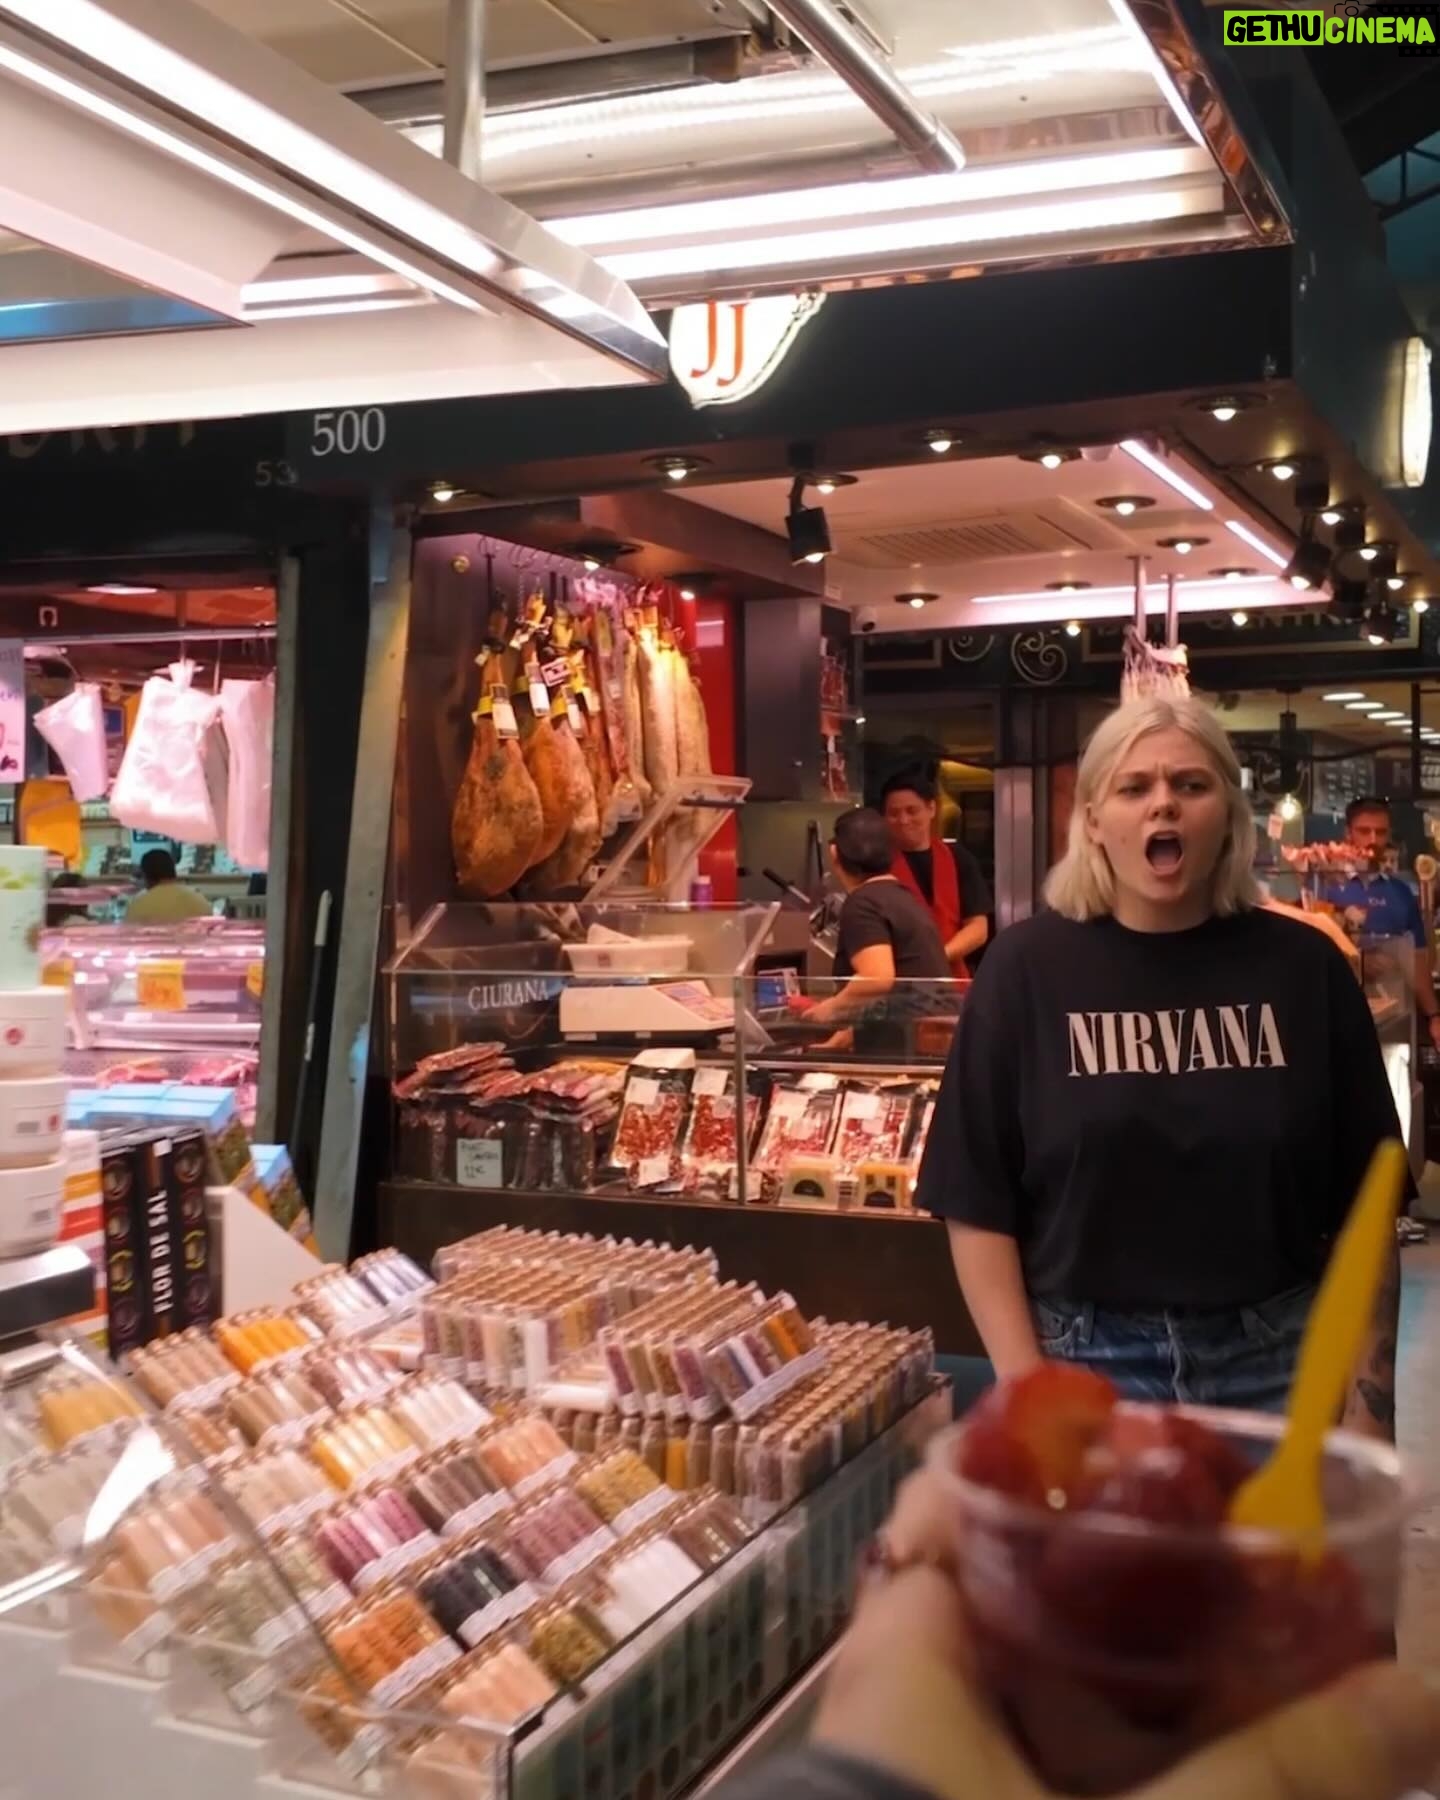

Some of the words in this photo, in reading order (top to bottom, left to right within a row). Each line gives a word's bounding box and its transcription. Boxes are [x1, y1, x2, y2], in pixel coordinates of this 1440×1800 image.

[690, 299, 749, 387] JJ
[311, 407, 386, 457] 500
[467, 978, 550, 1011] CIURANA
[1065, 1003, 1288, 1077] NIRVANA
[146, 1190, 168, 1228] SAL
[149, 1232, 171, 1259] DE
[151, 1263, 174, 1314] FLOR
